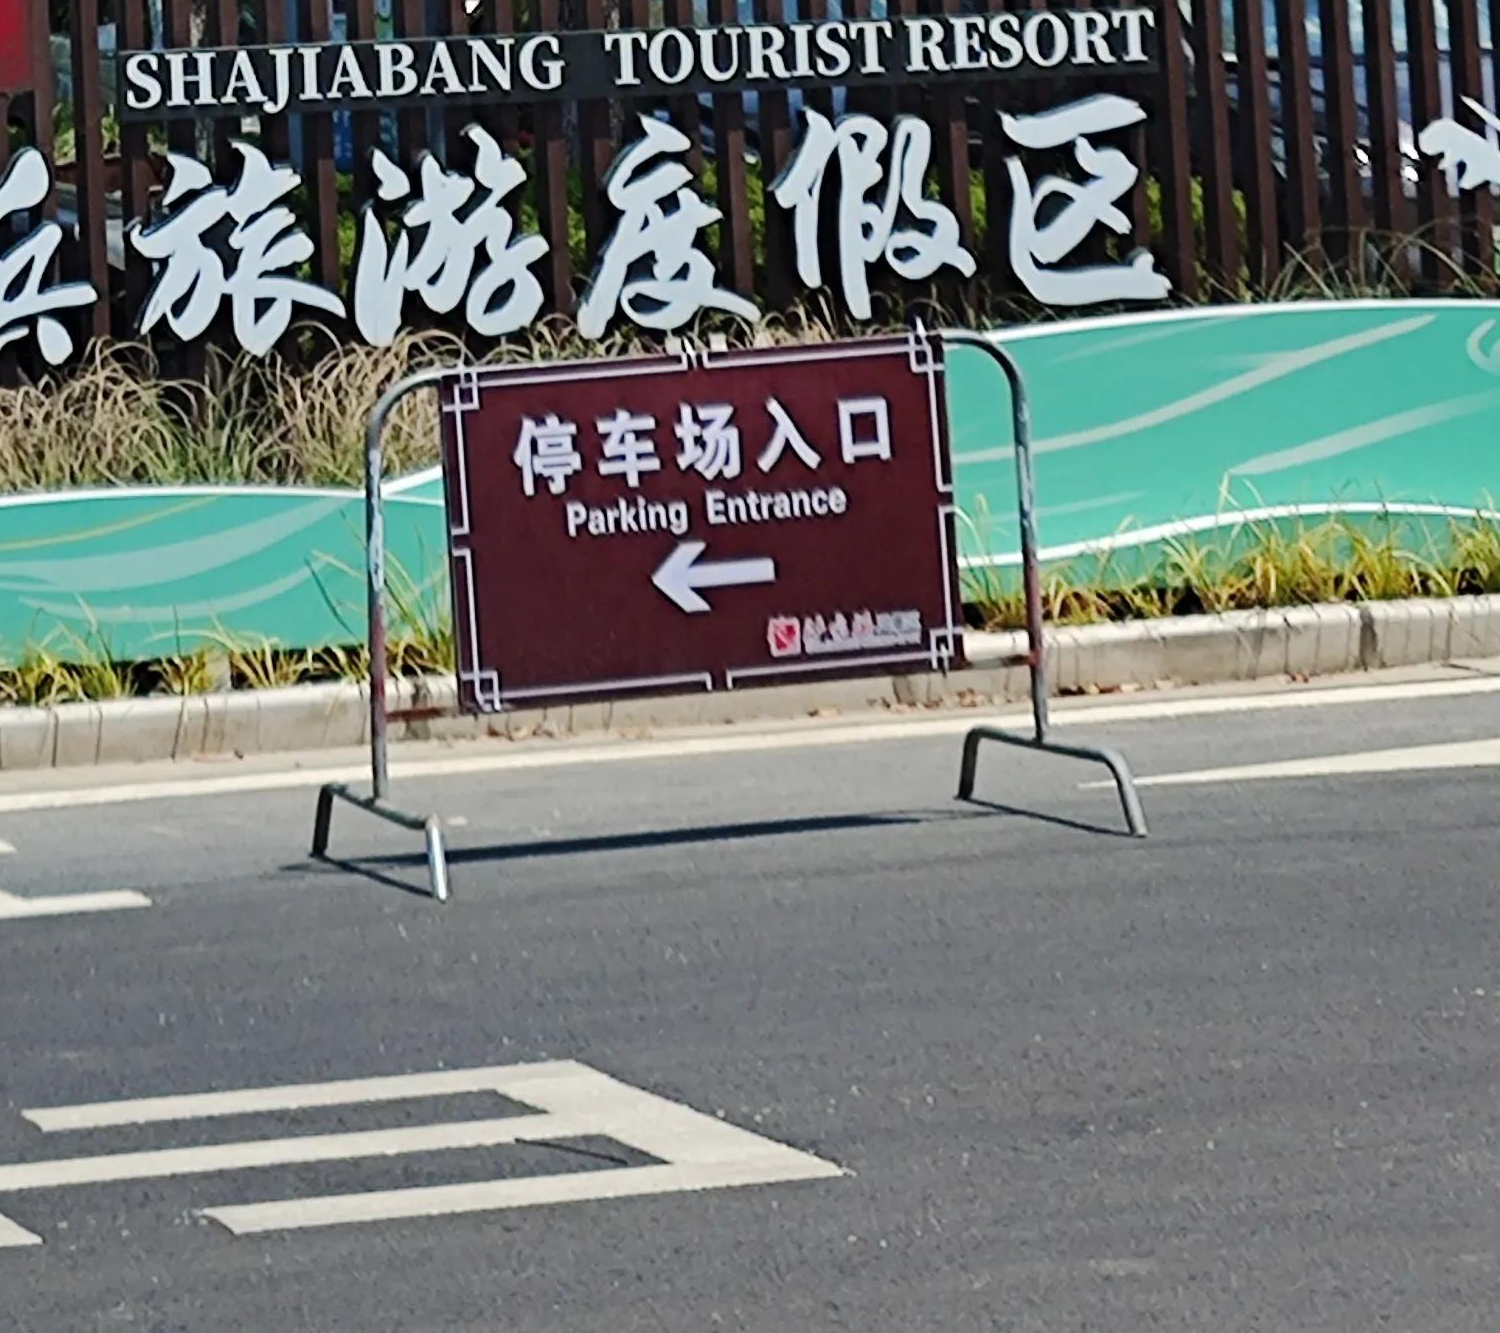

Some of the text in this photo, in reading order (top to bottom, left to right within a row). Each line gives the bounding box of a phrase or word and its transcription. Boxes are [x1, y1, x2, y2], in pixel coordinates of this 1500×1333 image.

[124, 8, 1157, 114] SHAJIABANG TOURIST RESORT
[513, 395, 892, 498] 停车场入口
[566, 486, 847, 537] Parking Entrance
